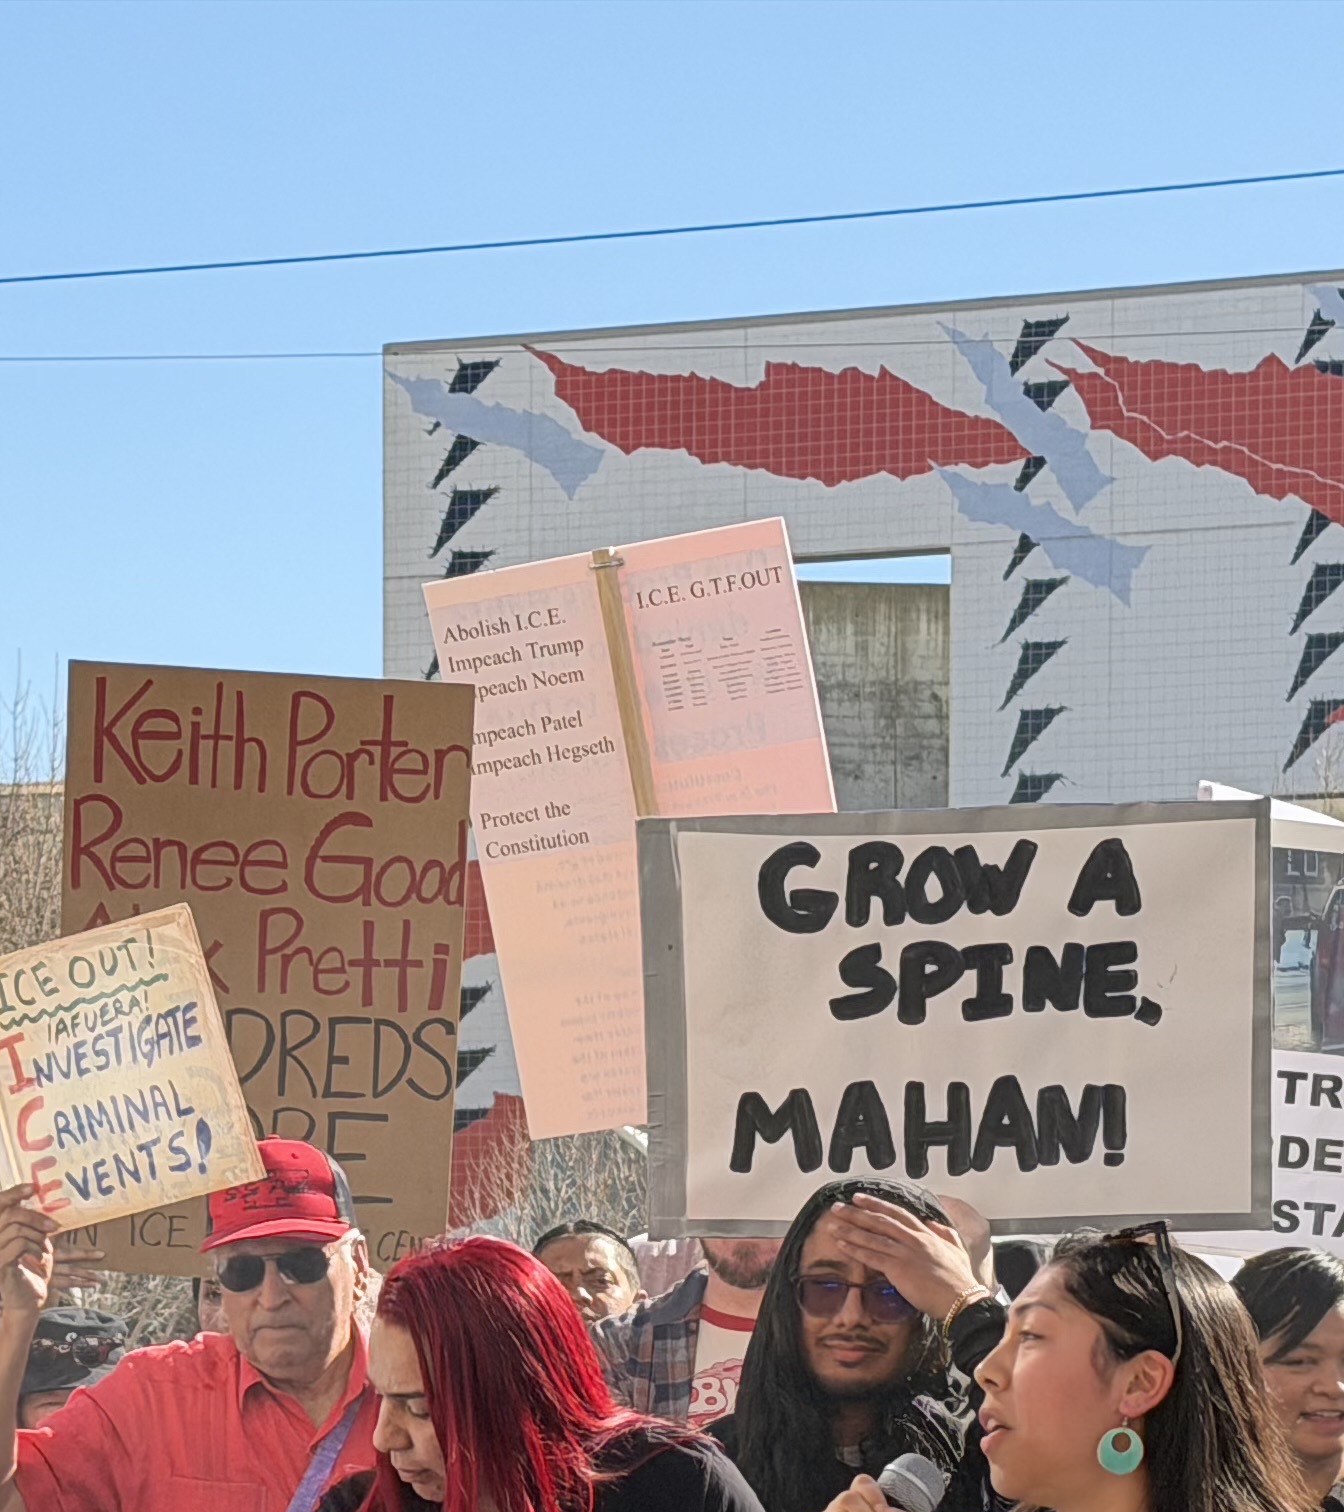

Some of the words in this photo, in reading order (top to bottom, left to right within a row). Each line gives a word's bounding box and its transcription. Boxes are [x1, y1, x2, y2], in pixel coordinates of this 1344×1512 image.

[636, 586, 686, 609] I.C.E.
[690, 566, 783, 600] G.T.F.OUT
[444, 615, 511, 645] Abolish
[516, 608, 566, 631] I.C.E.
[449, 647, 522, 674] Impeach
[527, 639, 584, 660] Trump
[475, 675, 527, 703] peach
[531, 669, 585, 690] Noem
[93, 677, 267, 793] Keith
[287, 691, 471, 803] Porter
[473, 719, 536, 748] mpeach
[541, 710, 583, 733] Patel
[547, 736, 616, 763] Hegseth
[481, 807, 540, 830] Protect
[545, 801, 571, 818] the
[71, 795, 288, 894] Renee
[305, 812, 468, 907] Good
[486, 831, 590, 859] Constitution
[758, 839, 1038, 932] GROW
[1067, 837, 1142, 917] A
[69, 929, 155, 988] OUT!
[257, 907, 450, 1012] Pretti
[829, 940, 1163, 1026] SPINE,
[226, 1007, 456, 1100] DREDS
[17, 1080, 196, 1151] CRIMINAL
[729, 1075, 1127, 1178] MAHAN!
[128, 1212, 194, 1250] ICE
